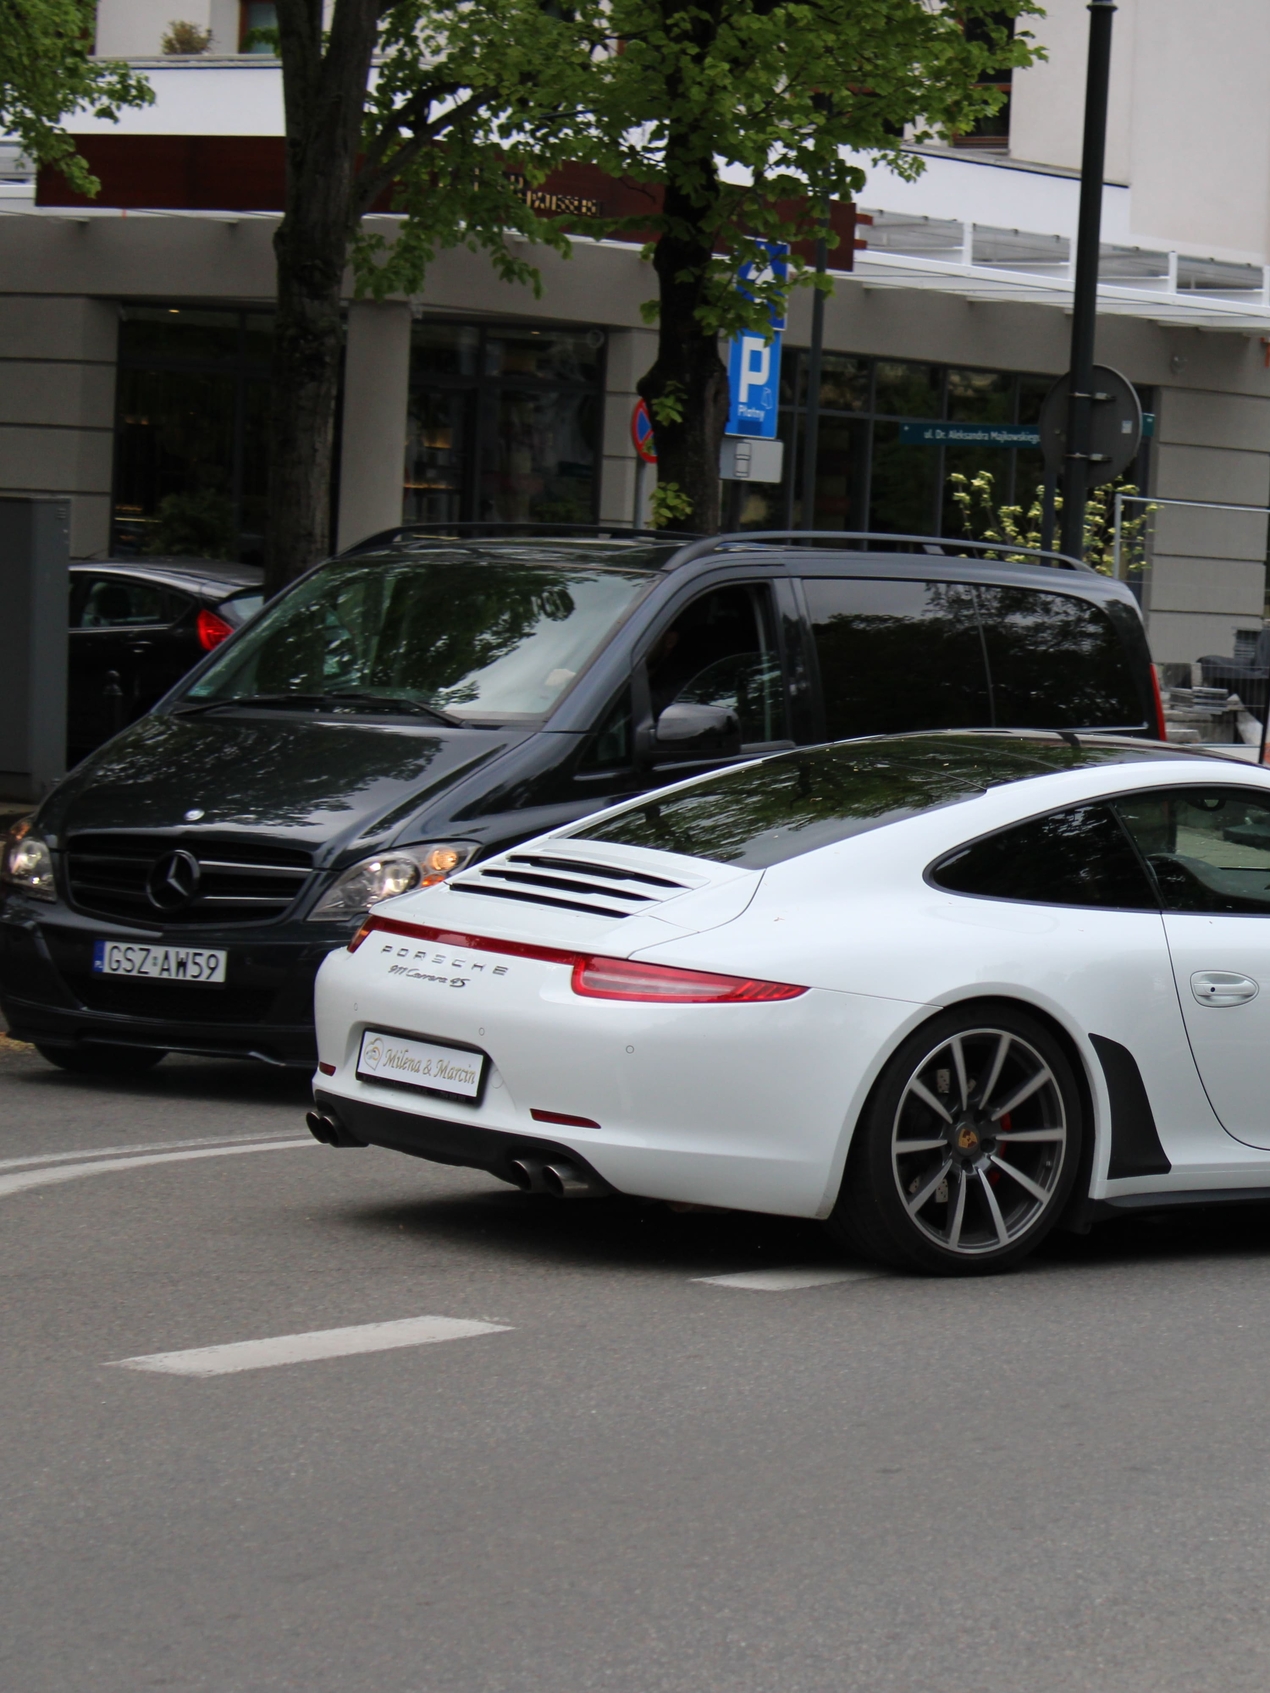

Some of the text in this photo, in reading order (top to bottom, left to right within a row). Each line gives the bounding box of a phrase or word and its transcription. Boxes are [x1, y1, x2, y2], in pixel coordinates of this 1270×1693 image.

[738, 336, 771, 403] P
[948, 430, 989, 440] Aleksandra
[108, 945, 219, 980] GSZ AW59
[381, 945, 509, 976] PORSCHE
[388, 964, 471, 988] 911 Carrera 4S
[383, 1048, 477, 1085] Milena & Marcin
